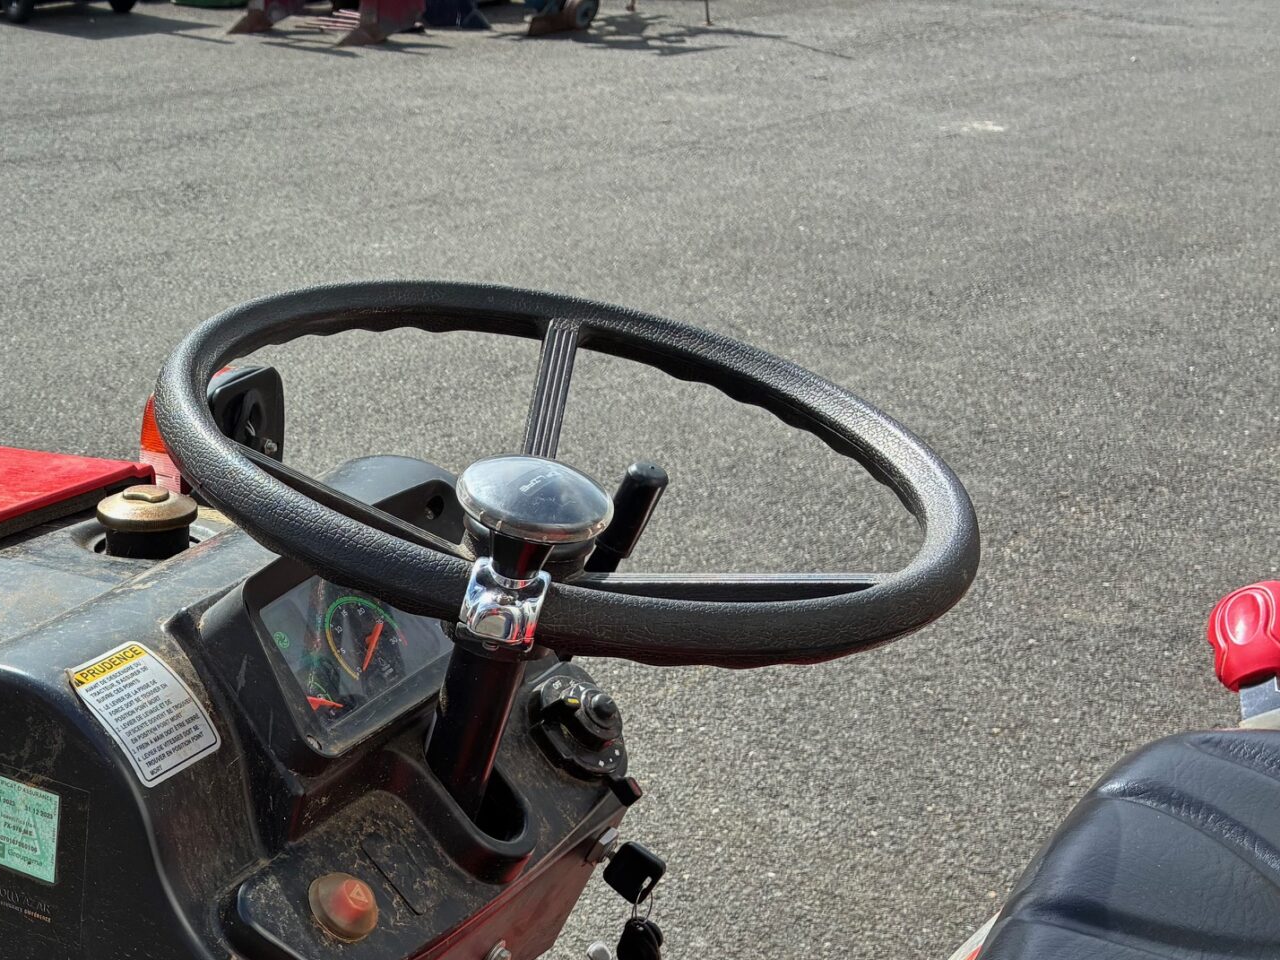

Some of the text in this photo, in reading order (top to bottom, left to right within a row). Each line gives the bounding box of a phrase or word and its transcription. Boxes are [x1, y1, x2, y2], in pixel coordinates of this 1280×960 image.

[80, 647, 142, 681] PRUDENCE
[110, 695, 125, 706] LEVIER
[114, 696, 161, 722] POSITION POINT MORT
[125, 700, 135, 708] DOIT
[120, 719, 136, 729] LEVIER
[125, 721, 149, 737] DESCENTE
[136, 742, 149, 751] FREIN
[153, 733, 164, 742] MAIN
[164, 727, 174, 736] DOIT
[142, 748, 157, 760] LEVIER
[183, 728, 194, 736] DOIT
[146, 753, 166, 767] TROUVER
[172, 739, 192, 753] POSITION
[191, 732, 204, 743] POINT
[150, 765, 163, 775] MORT
[7, 847, 42, 868] Groupama
